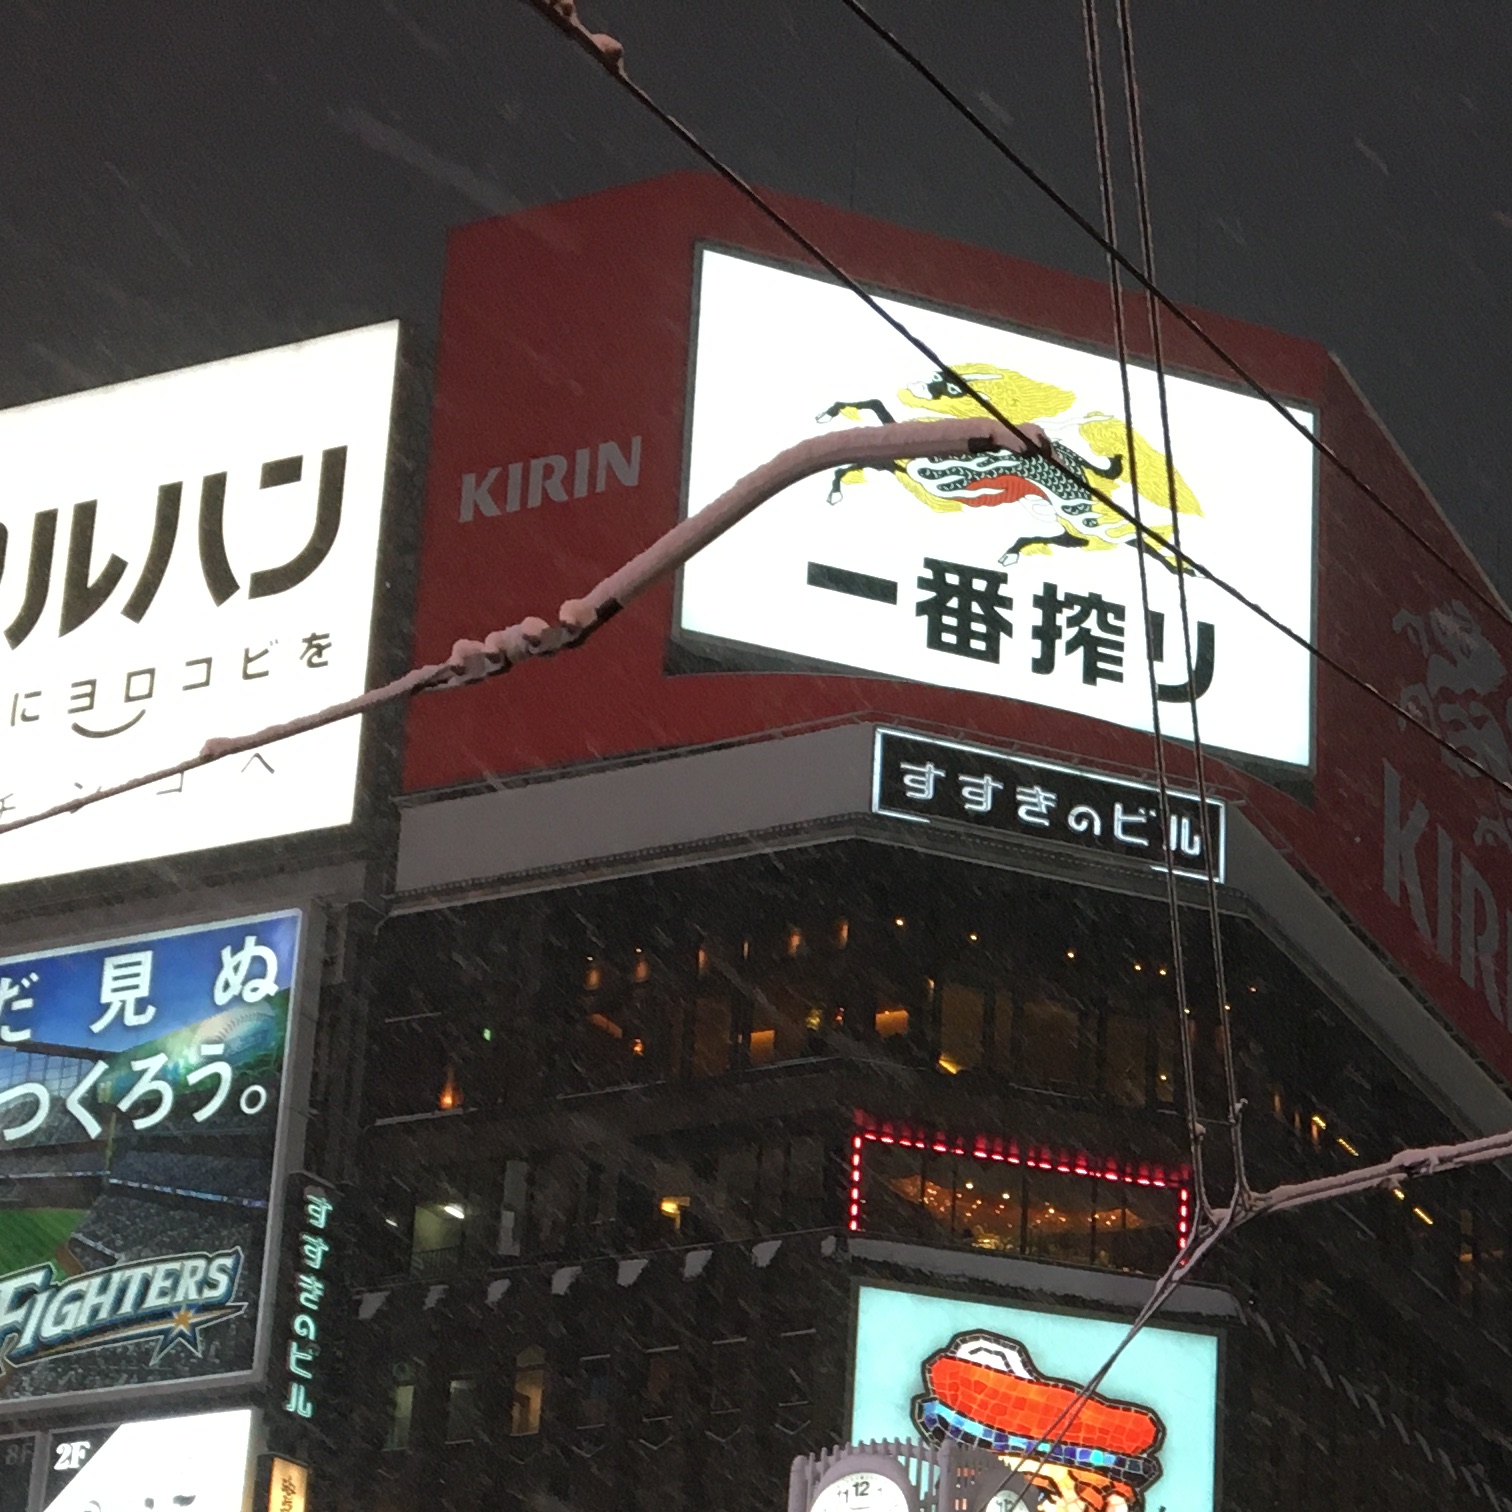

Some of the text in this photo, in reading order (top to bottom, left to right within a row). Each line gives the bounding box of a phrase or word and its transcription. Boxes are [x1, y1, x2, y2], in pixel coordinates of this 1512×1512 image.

[458, 436, 642, 523] KIRIN
[0, 445, 348, 651] ルハン
[807, 557, 1215, 703] 一番搾り
[900, 761, 1201, 856] すすきのビル
[0, 1246, 244, 1352] FIGHTERS
[285, 1192, 334, 1418] すすきのビル
[53, 1441, 91, 1471] 2F
[853, 1481, 870, 1497] 12
